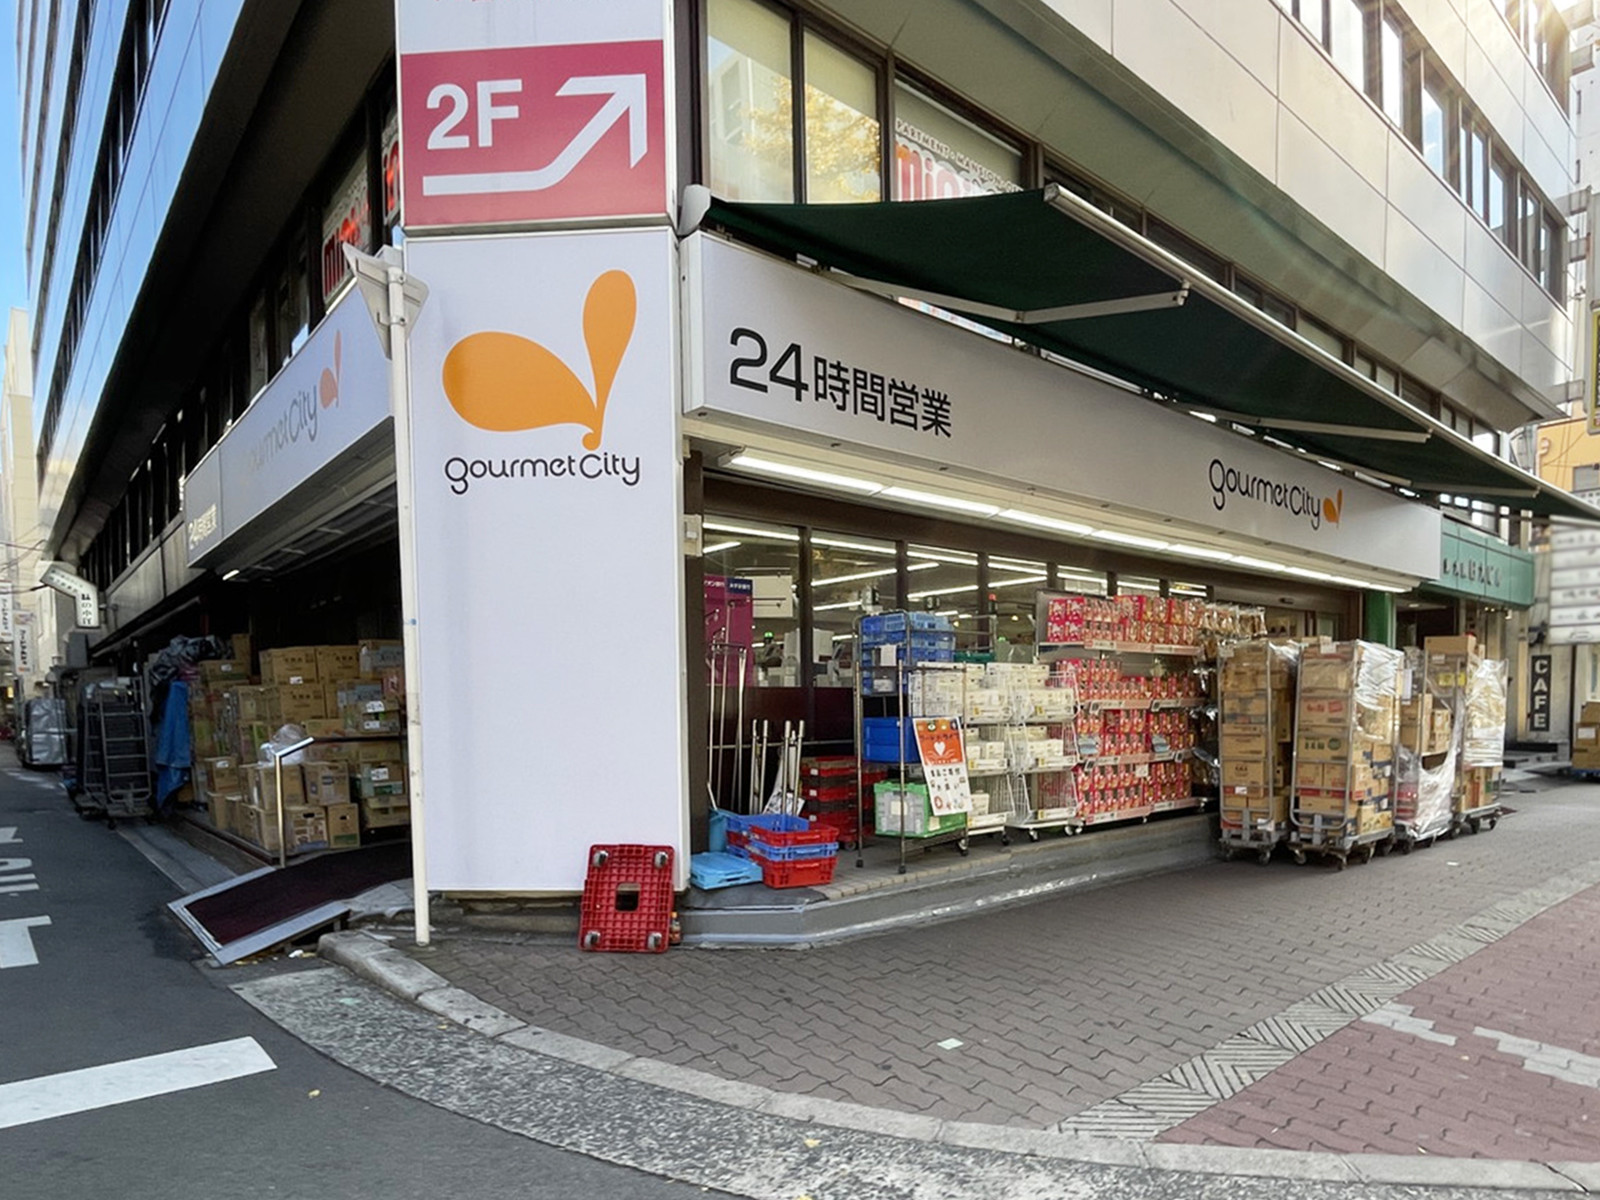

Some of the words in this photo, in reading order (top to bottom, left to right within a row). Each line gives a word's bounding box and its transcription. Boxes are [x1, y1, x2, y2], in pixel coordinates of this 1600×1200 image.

[426, 79, 523, 150] 2F
[730, 327, 952, 438] 24時間営業
[445, 452, 640, 495] gourmetCity
[1209, 458, 1321, 530] gourmetCity
[1533, 659, 1548, 728] CAFE
